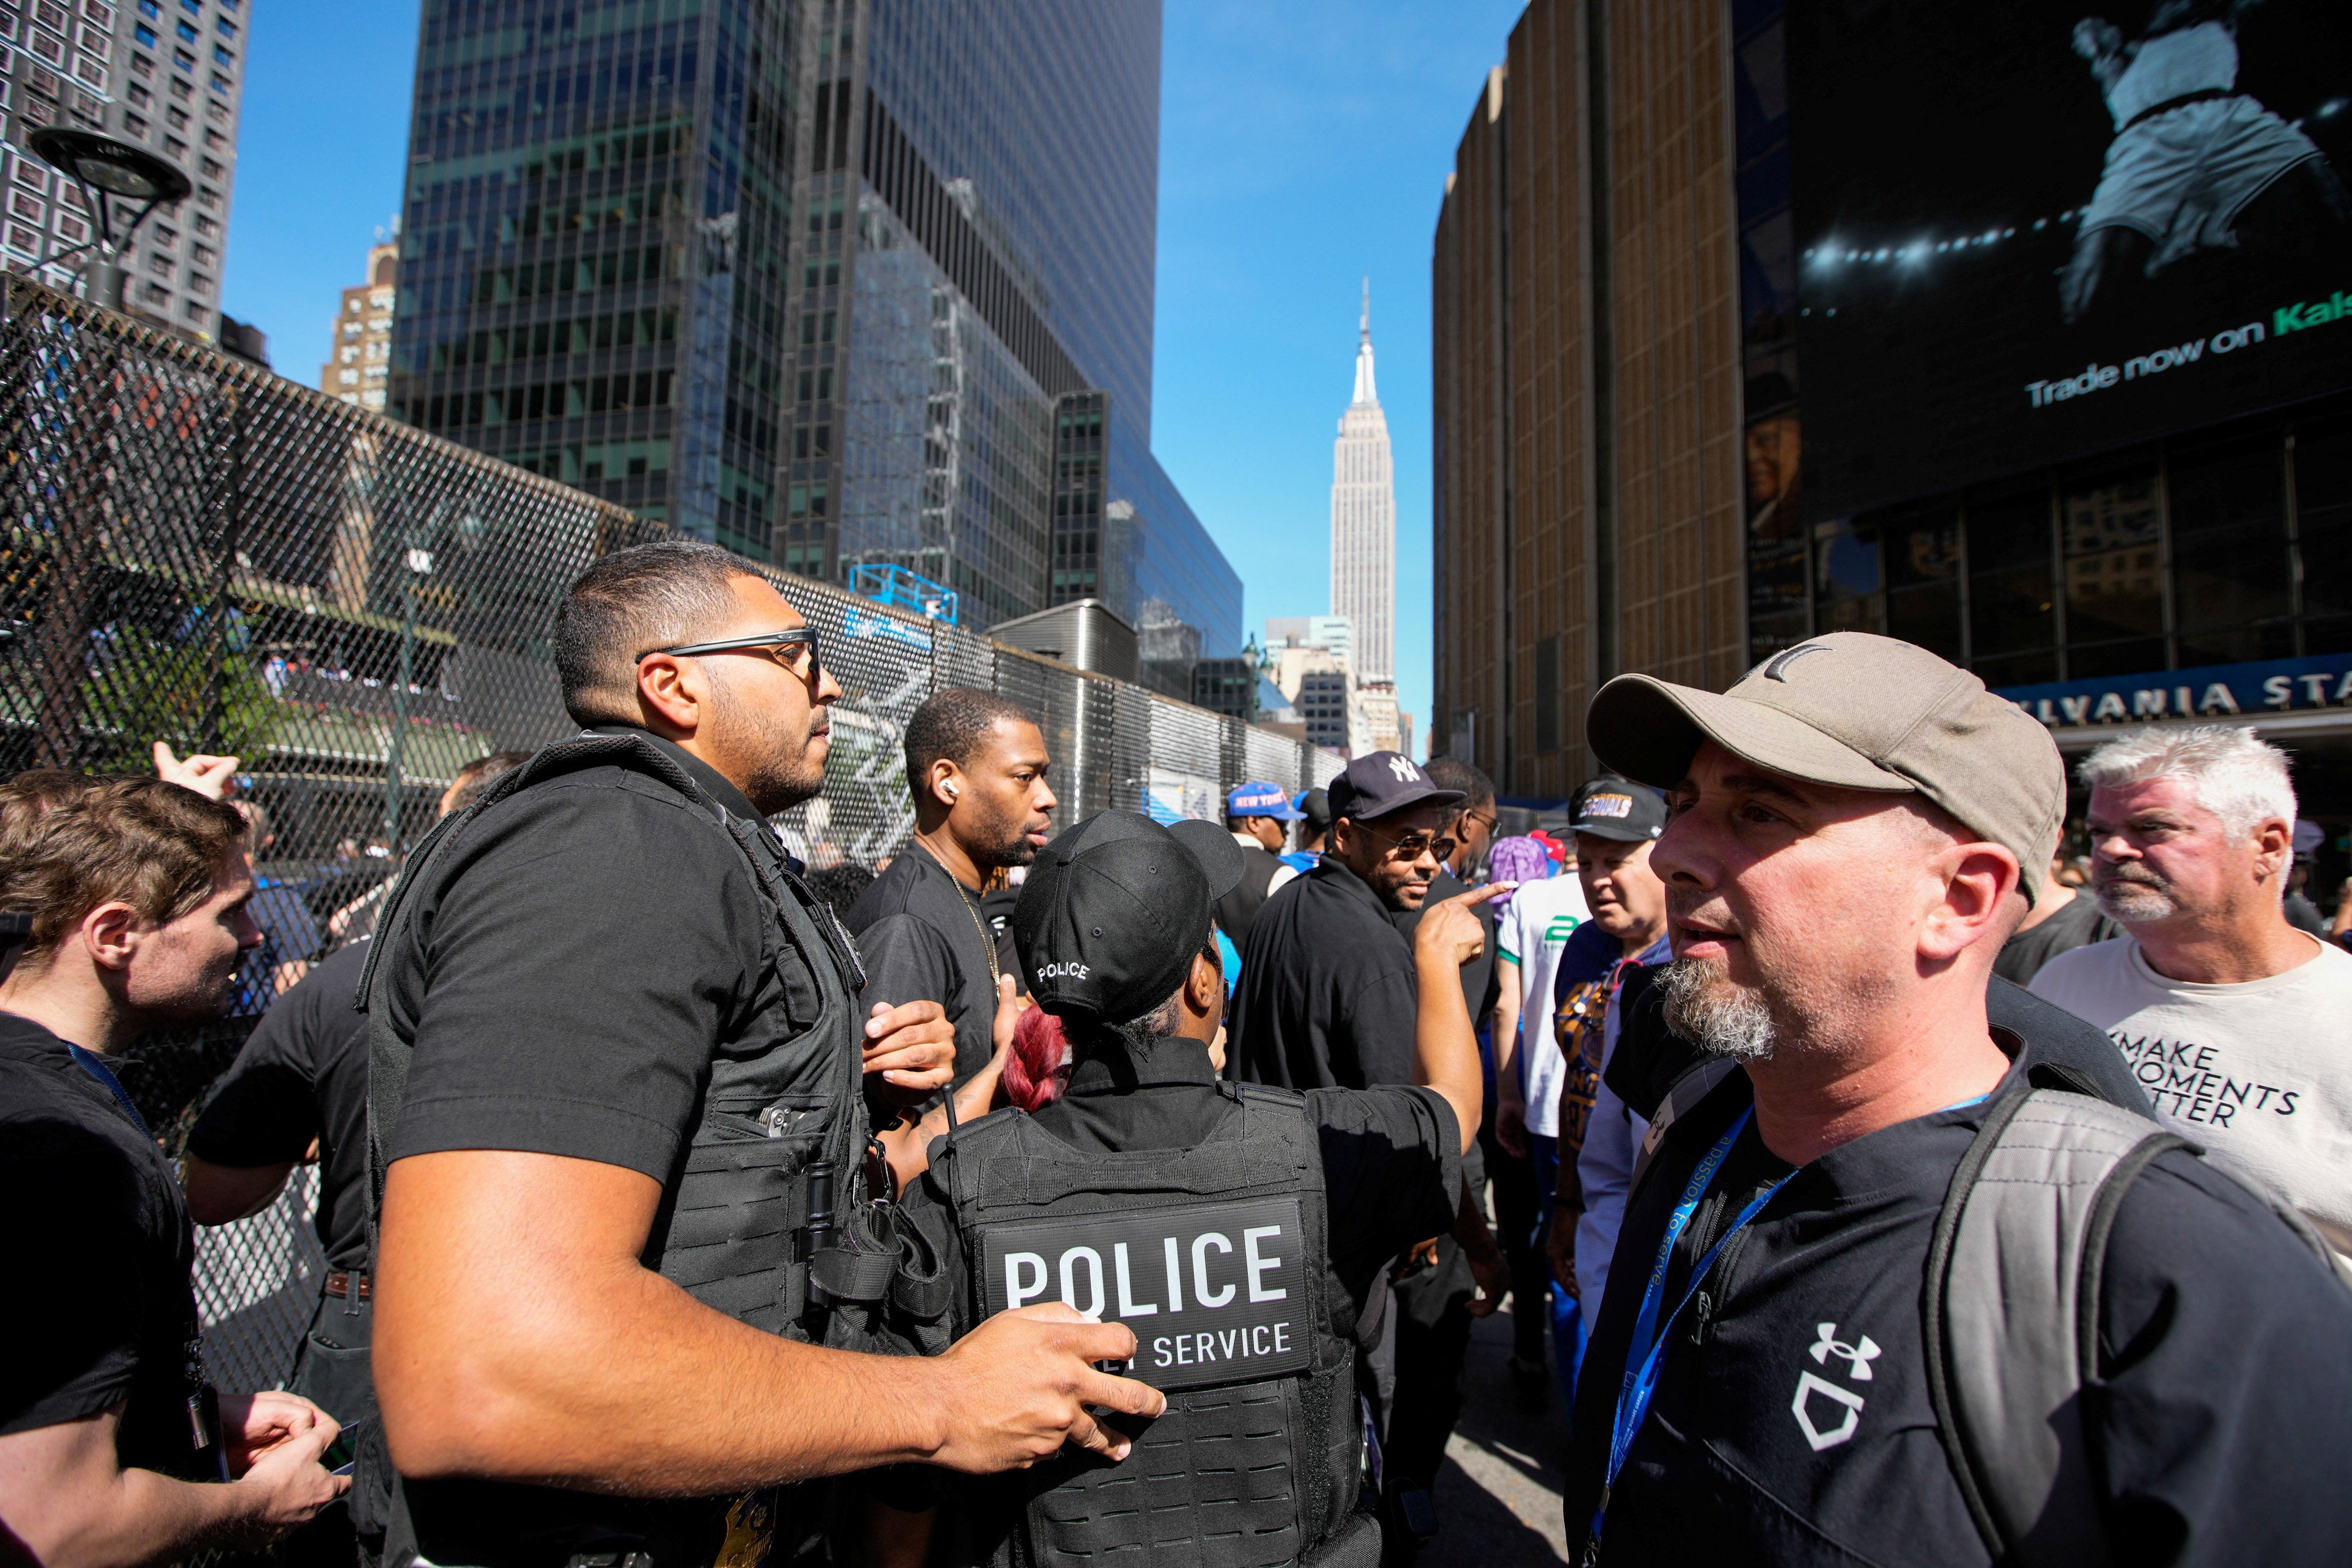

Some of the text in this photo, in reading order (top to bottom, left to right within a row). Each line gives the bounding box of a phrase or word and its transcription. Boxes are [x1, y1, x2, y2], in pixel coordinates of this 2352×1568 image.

[2024, 363, 2121, 408] Trade
[2124, 339, 2206, 381] now
[2210, 322, 2266, 353] on
[1235, 795, 1258, 808] NEW
[1036, 961, 1090, 983] POLICE
[2119, 1031, 2220, 1072] MAKE
[2130, 1059, 2300, 1115] OMENTS
[2150, 1086, 2235, 1128] TTER
[1720, 1136, 1732, 1145] a
[1680, 1147, 1724, 1208] passion
[1669, 1211, 1686, 1230] to
[1004, 1225, 1287, 1318] POLICE
[1154, 1322, 1292, 1368] SERVICE
[1628, 1407, 1638, 1427] SQUARE
[1635, 1390, 1645, 1409] GARDEN
